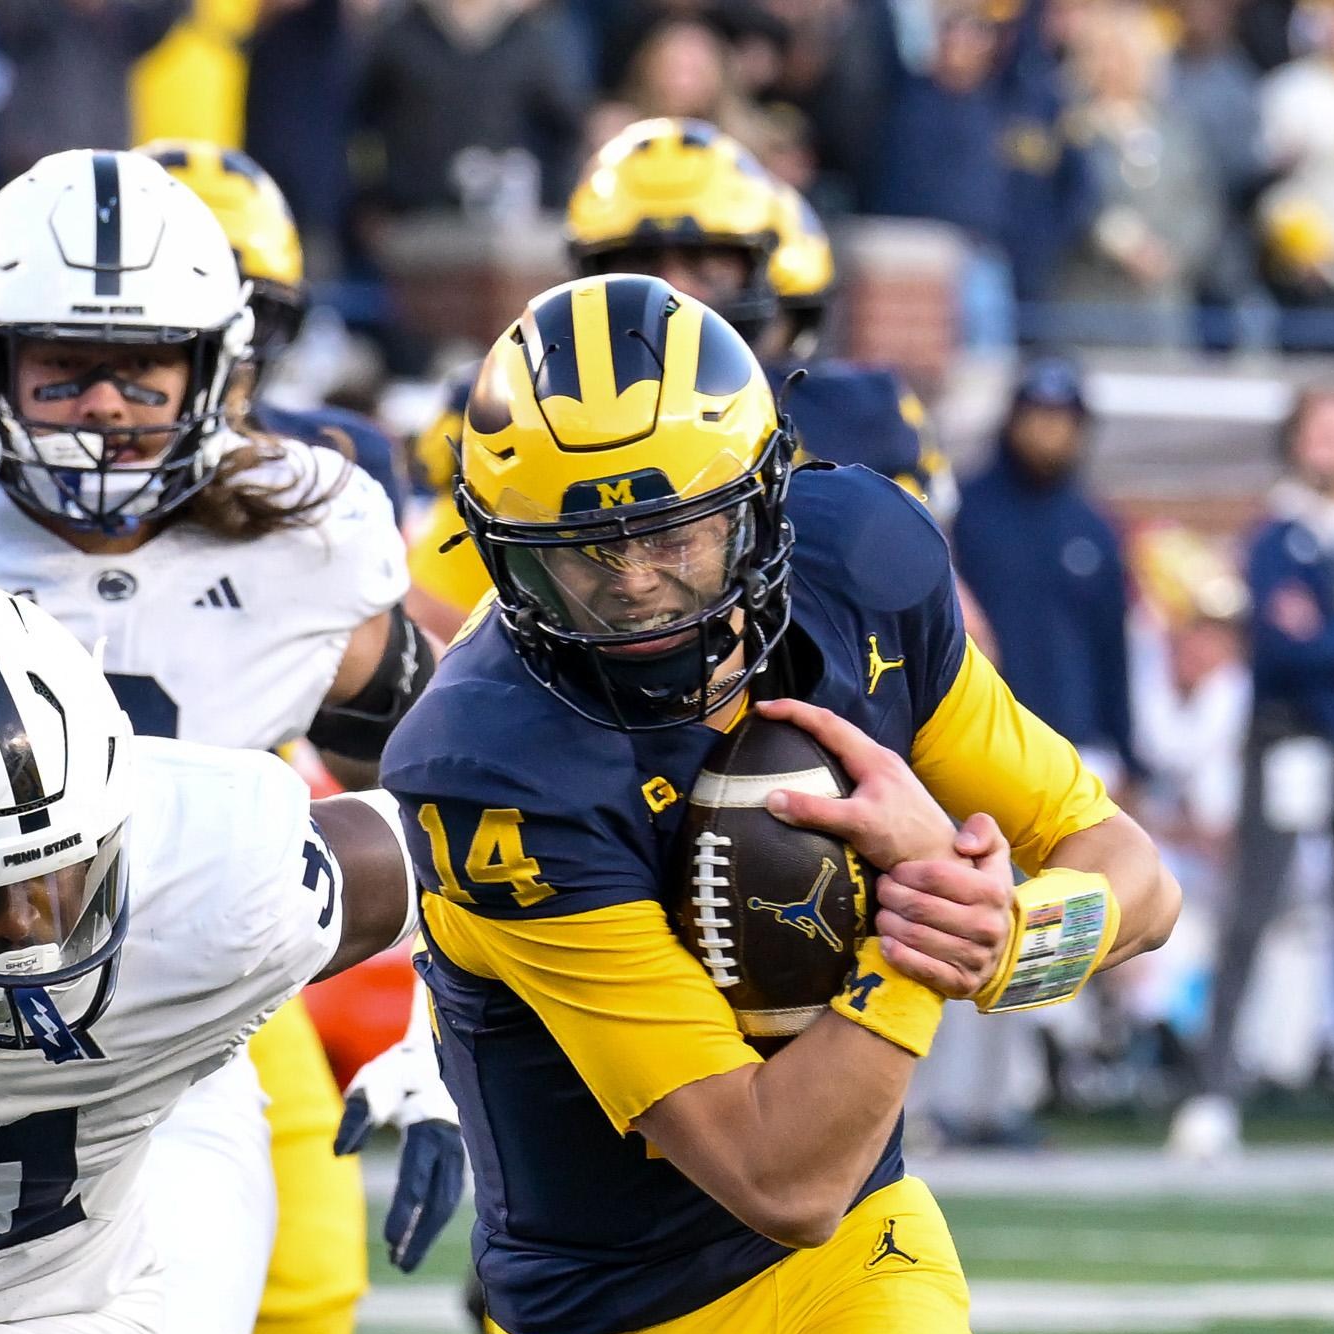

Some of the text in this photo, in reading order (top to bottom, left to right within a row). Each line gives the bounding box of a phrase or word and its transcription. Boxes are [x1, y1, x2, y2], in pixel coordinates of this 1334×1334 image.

[595, 478, 636, 510] M
[3, 832, 83, 867] PENN STATE
[417, 803, 558, 908] 14
